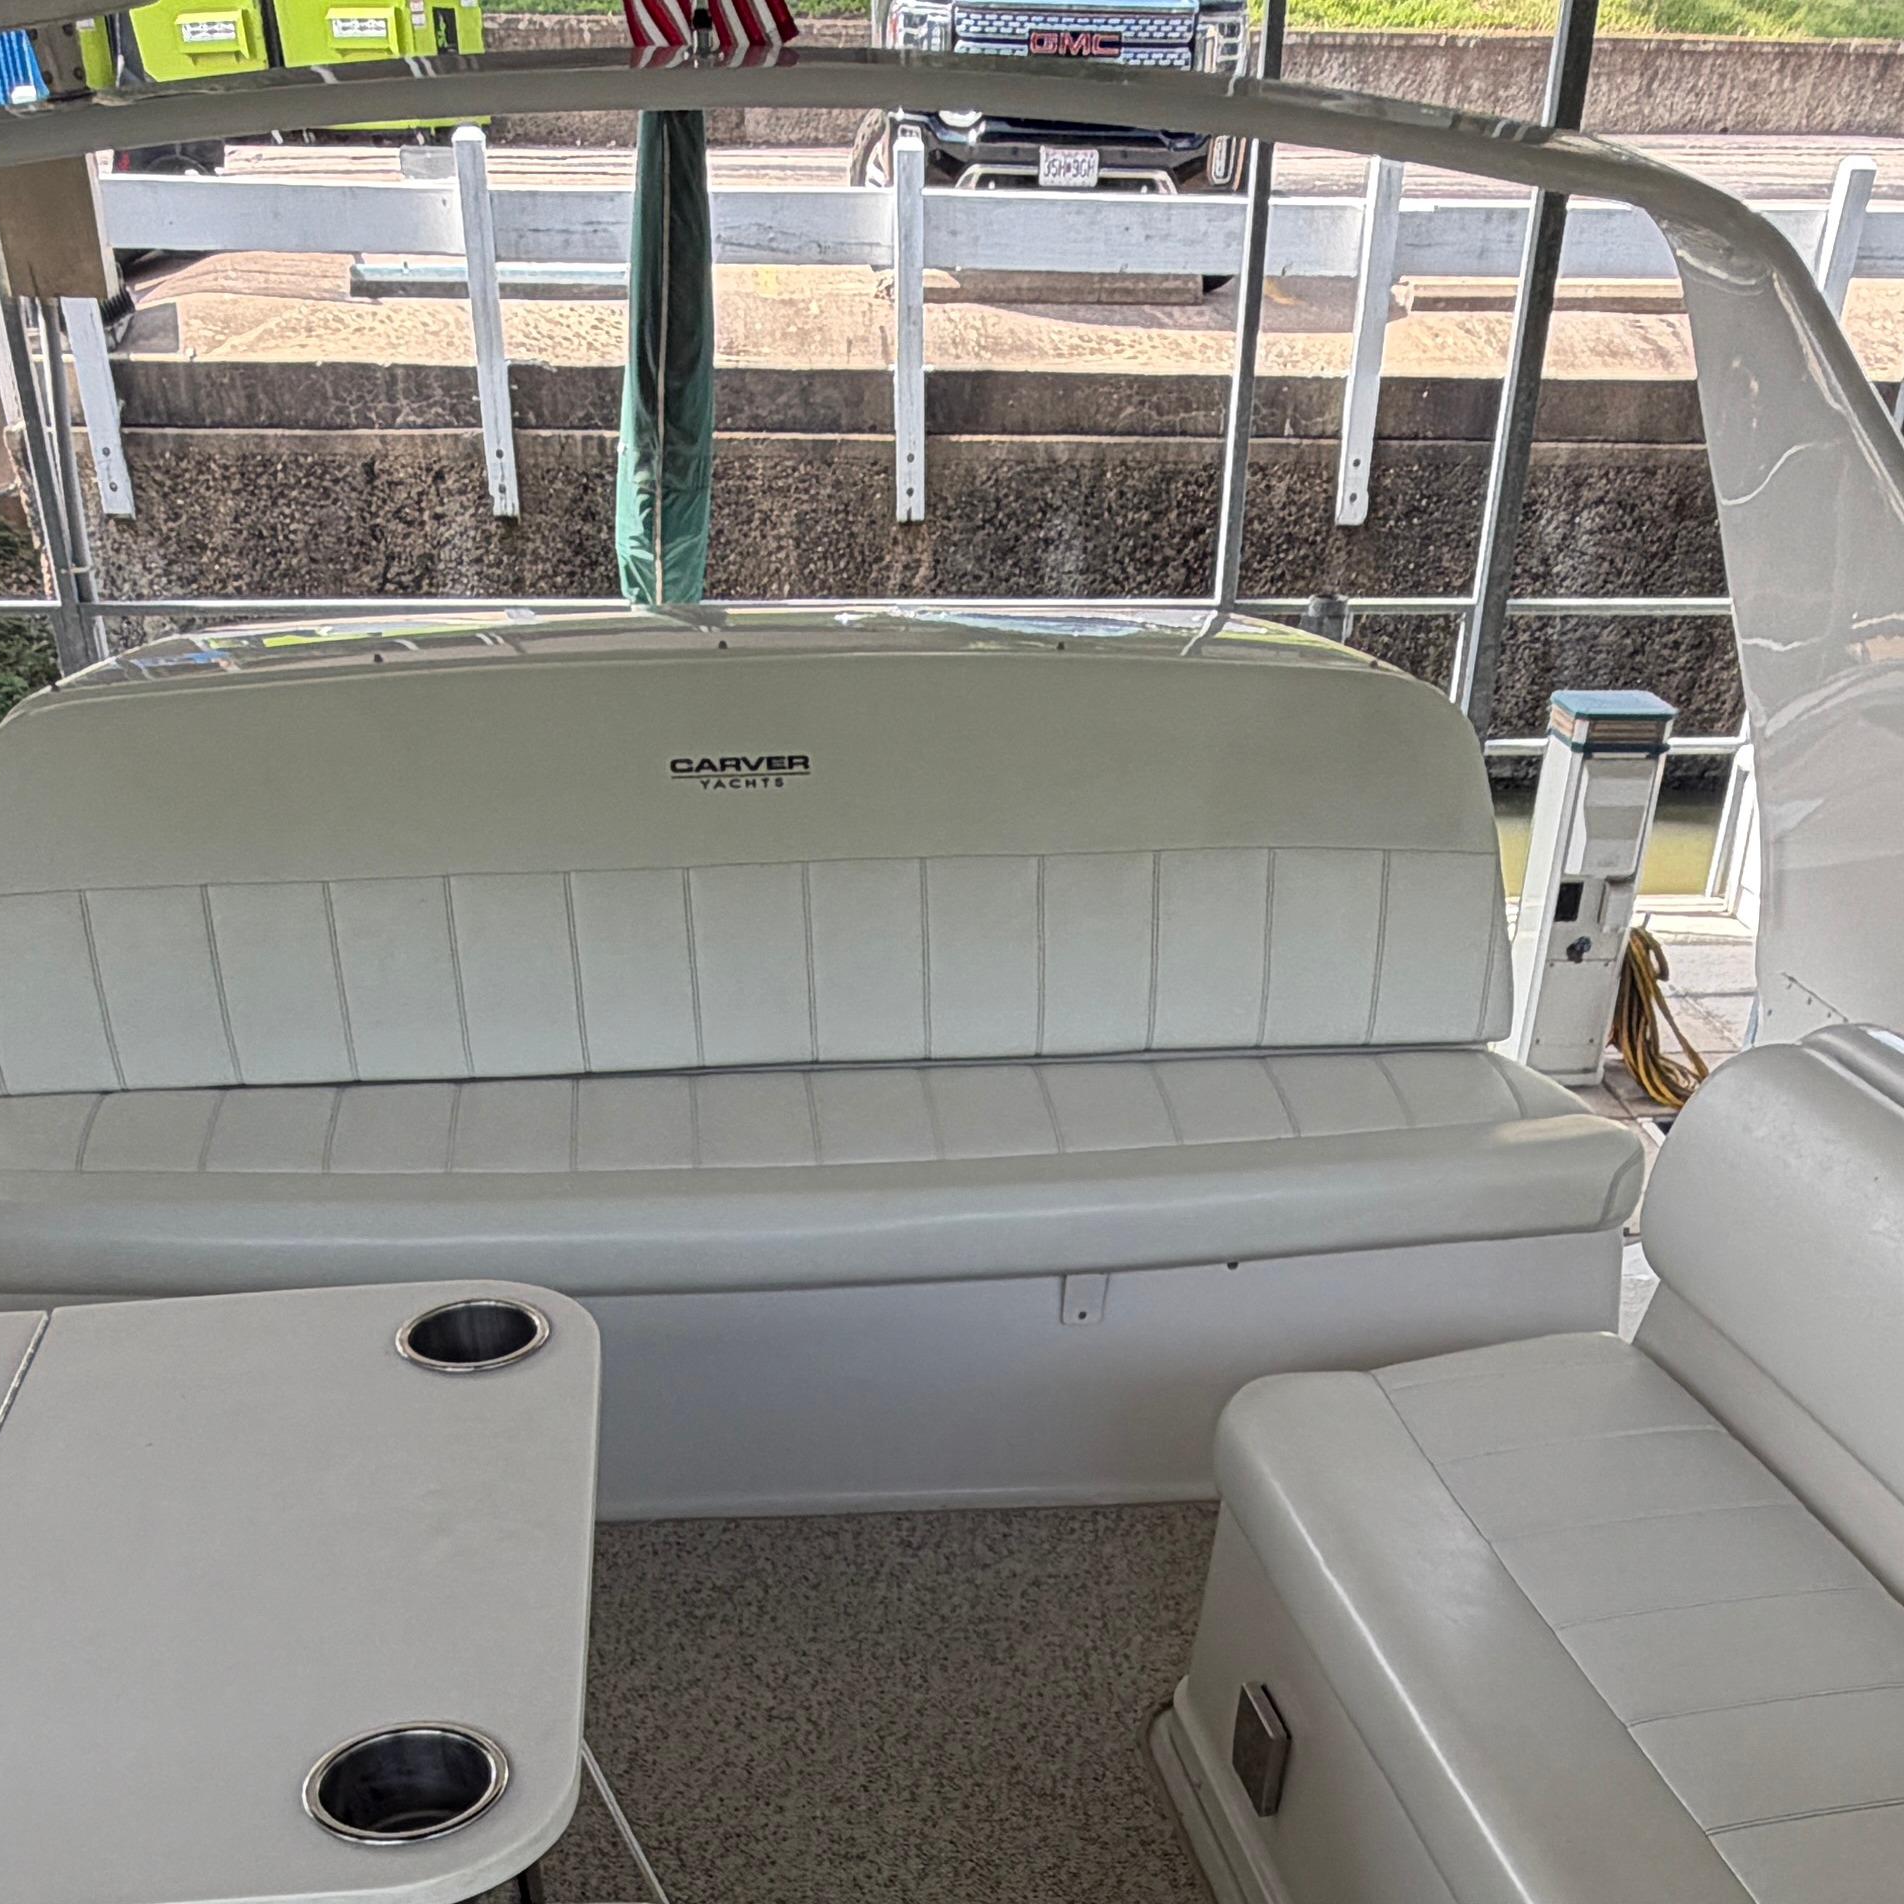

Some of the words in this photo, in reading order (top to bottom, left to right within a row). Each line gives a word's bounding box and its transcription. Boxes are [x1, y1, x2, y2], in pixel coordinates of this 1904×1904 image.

[1030, 31, 1120, 56] GMC
[669, 754, 810, 773] CARVER
[699, 776, 785, 790] YACHTS
